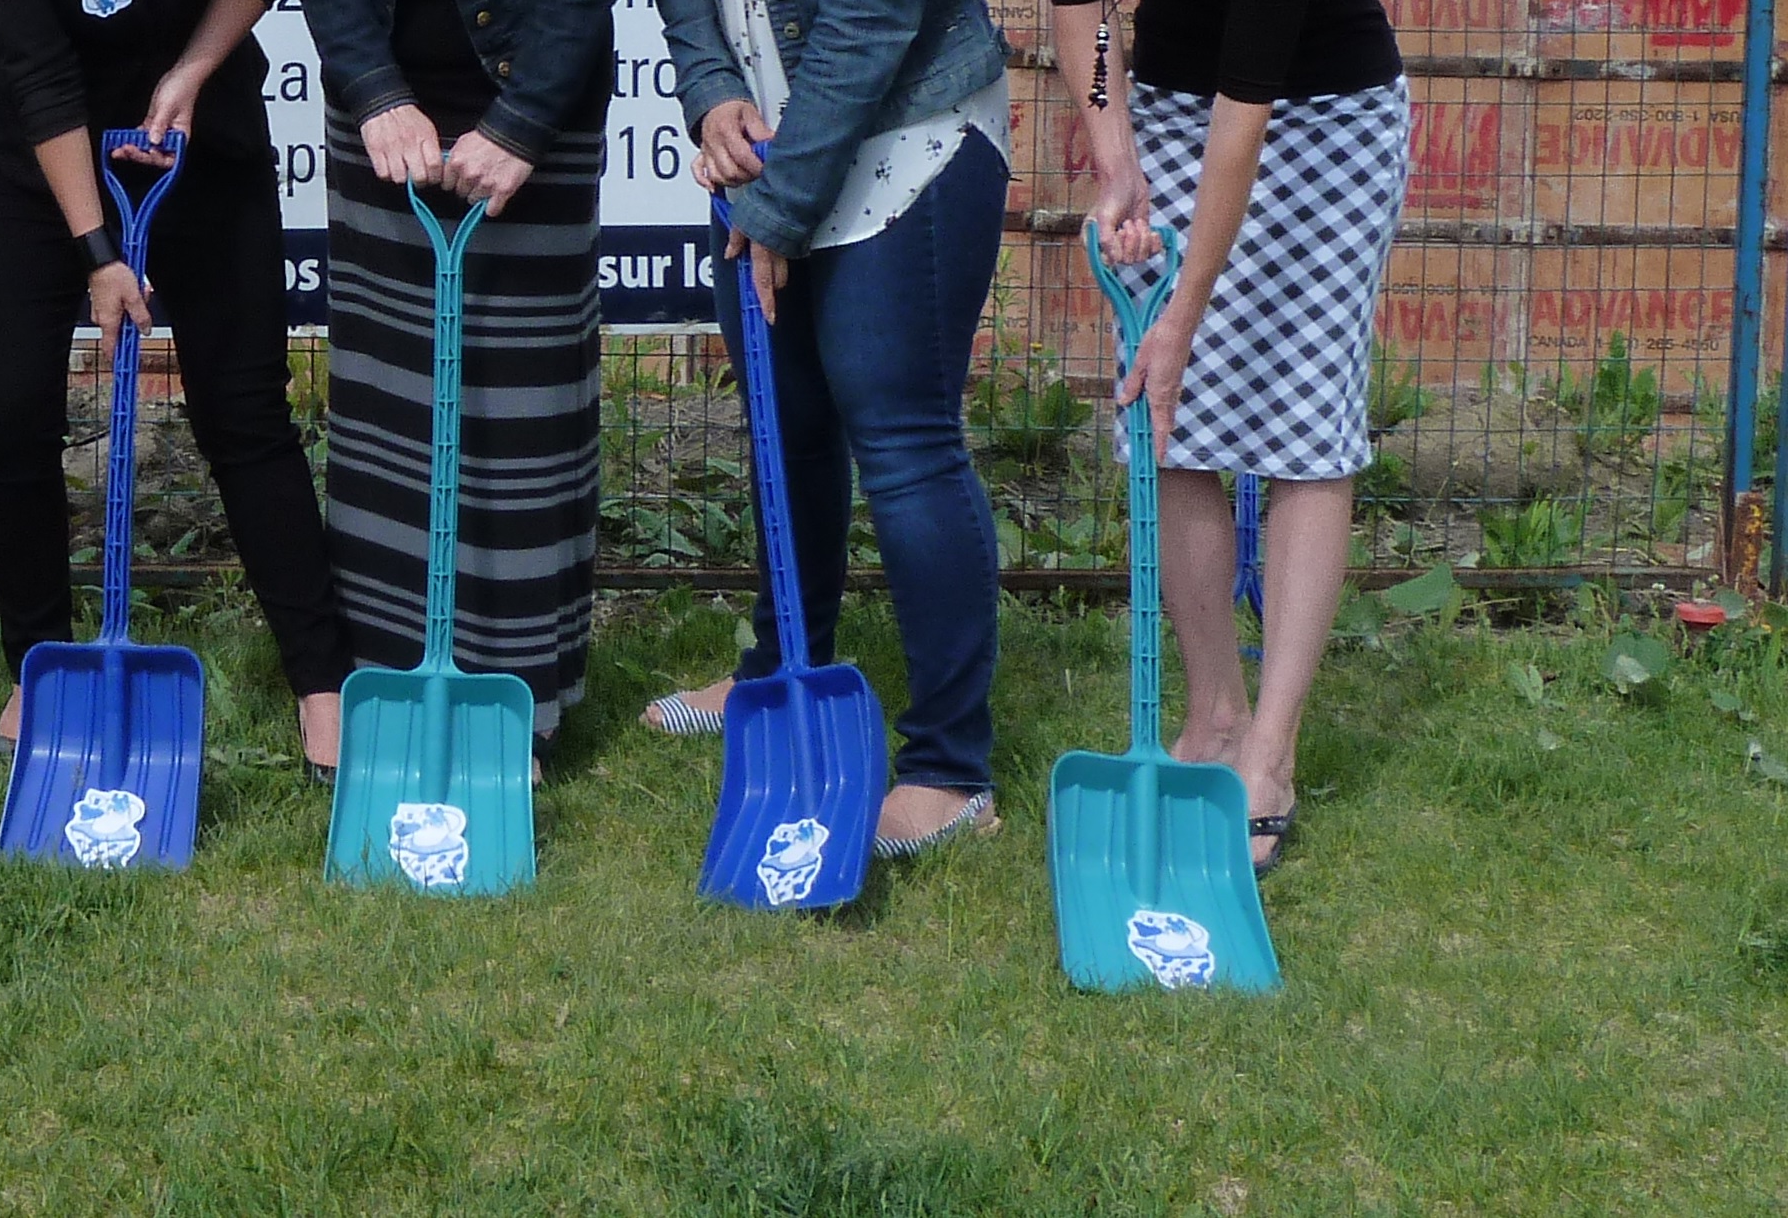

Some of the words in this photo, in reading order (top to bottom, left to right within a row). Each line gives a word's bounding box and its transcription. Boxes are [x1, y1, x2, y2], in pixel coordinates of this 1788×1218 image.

[601, 125, 680, 180] 16
[1537, 125, 1742, 169] ADVANCE
[598, 255, 672, 288] sur
